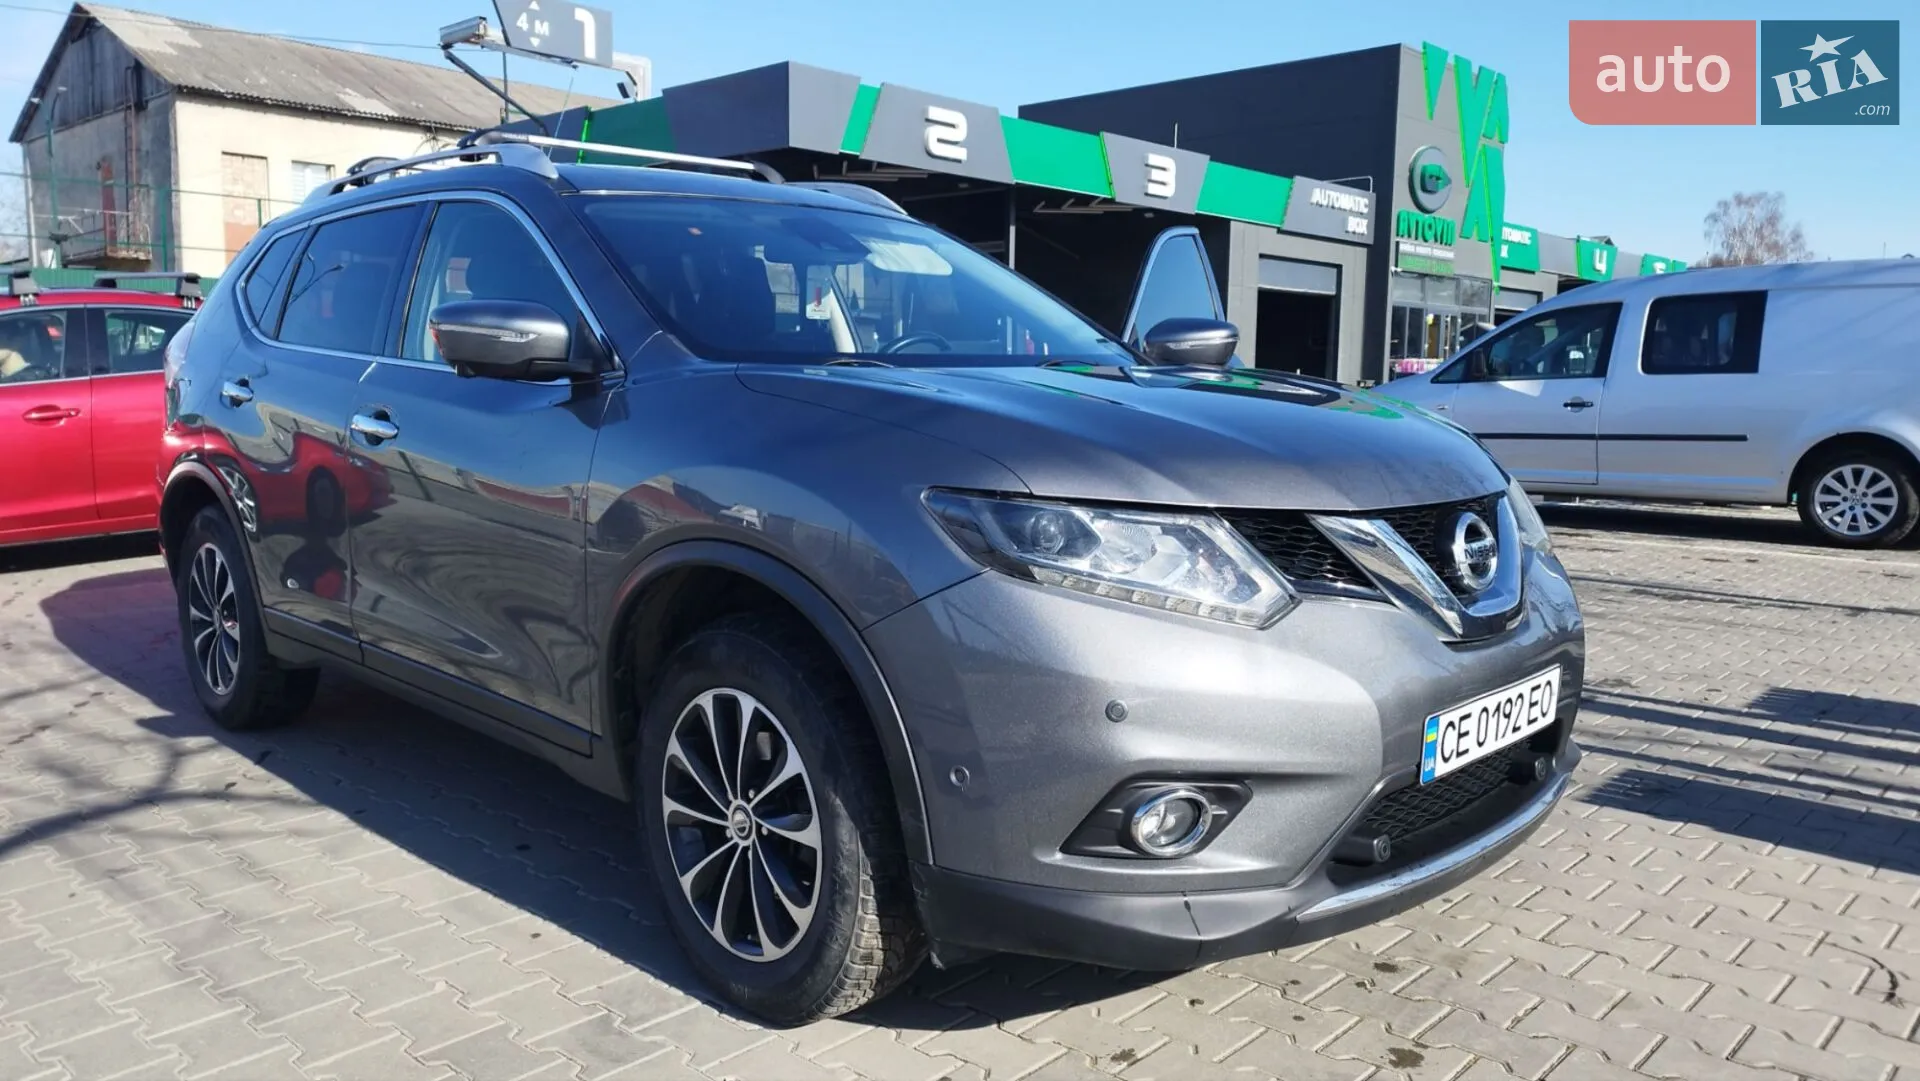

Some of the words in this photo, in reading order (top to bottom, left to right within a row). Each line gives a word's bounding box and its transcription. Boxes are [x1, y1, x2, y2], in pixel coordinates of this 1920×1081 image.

[516, 12, 529, 32] 4
[574, 7, 596, 59] 1
[924, 105, 968, 162] 2
[1145, 153, 1176, 198] 3
[1310, 187, 1369, 214] AUTOMATIC
[1346, 215, 1369, 234] BOX
[1476, 688, 1524, 748] 0192
